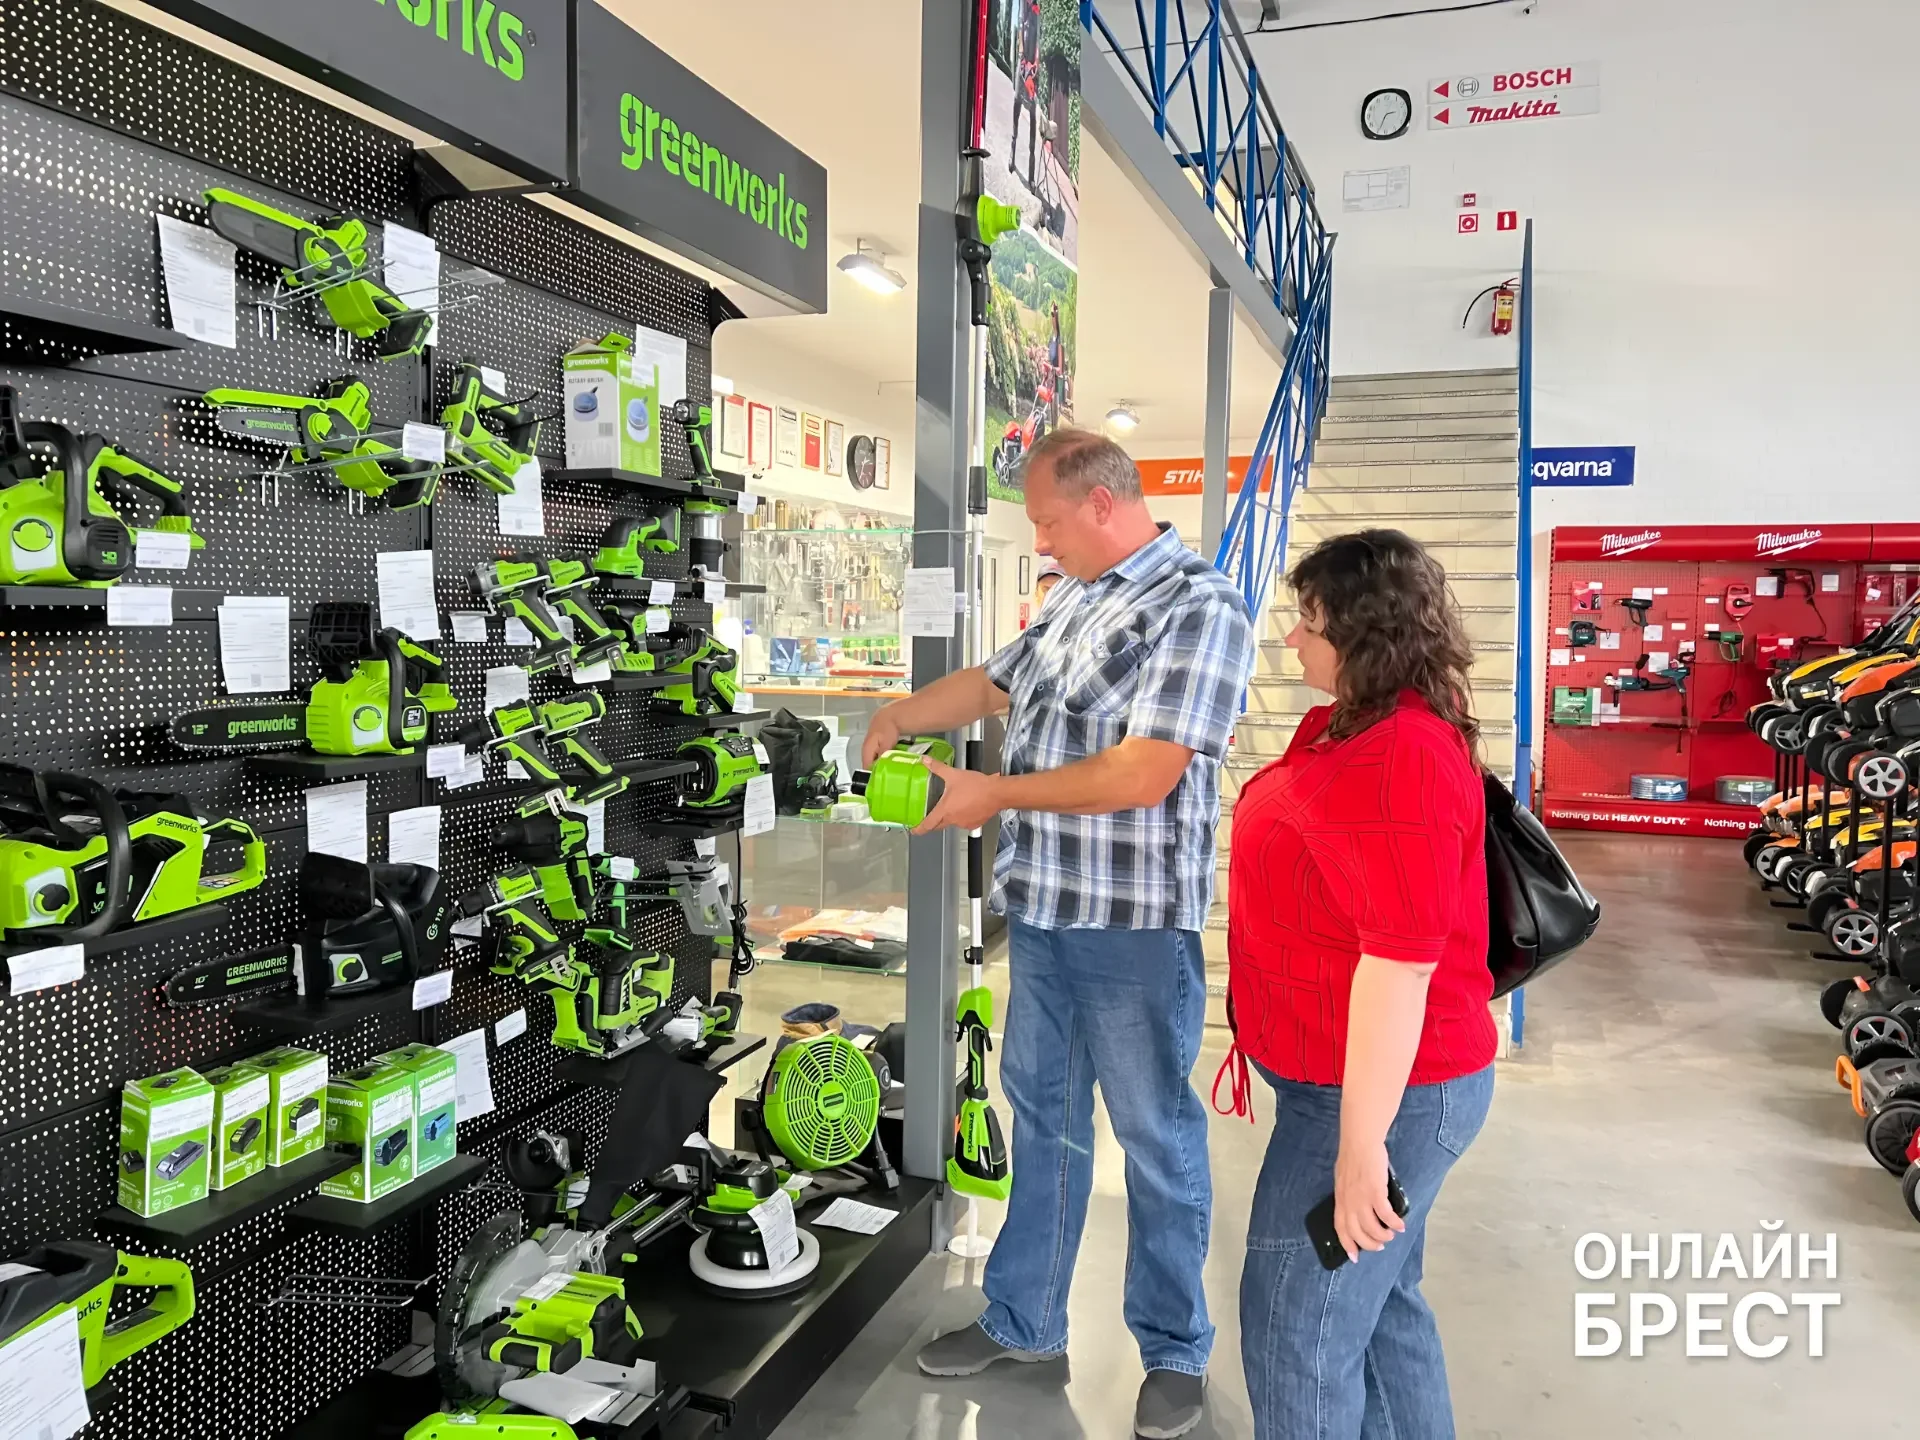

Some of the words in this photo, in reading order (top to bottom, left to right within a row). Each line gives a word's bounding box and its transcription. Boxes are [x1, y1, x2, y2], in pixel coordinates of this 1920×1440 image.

[1493, 68, 1572, 92] BOSCH
[620, 92, 808, 250] greenworks
[246, 419, 295, 432] greenworks
[1530, 460, 1612, 480] qvarna
[1600, 530, 1662, 552] Milwaukee
[1755, 529, 1822, 551] Milwaukee
[228, 714, 297, 738] greenworks
[156, 817, 198, 833] greenworks
[1551, 810, 1590, 822] Nothing
[1592, 812, 1609, 822] but
[1612, 814, 1650, 824] HEAVY
[1704, 818, 1746, 830] Nothing
[226, 956, 288, 978] GREENWORKS
